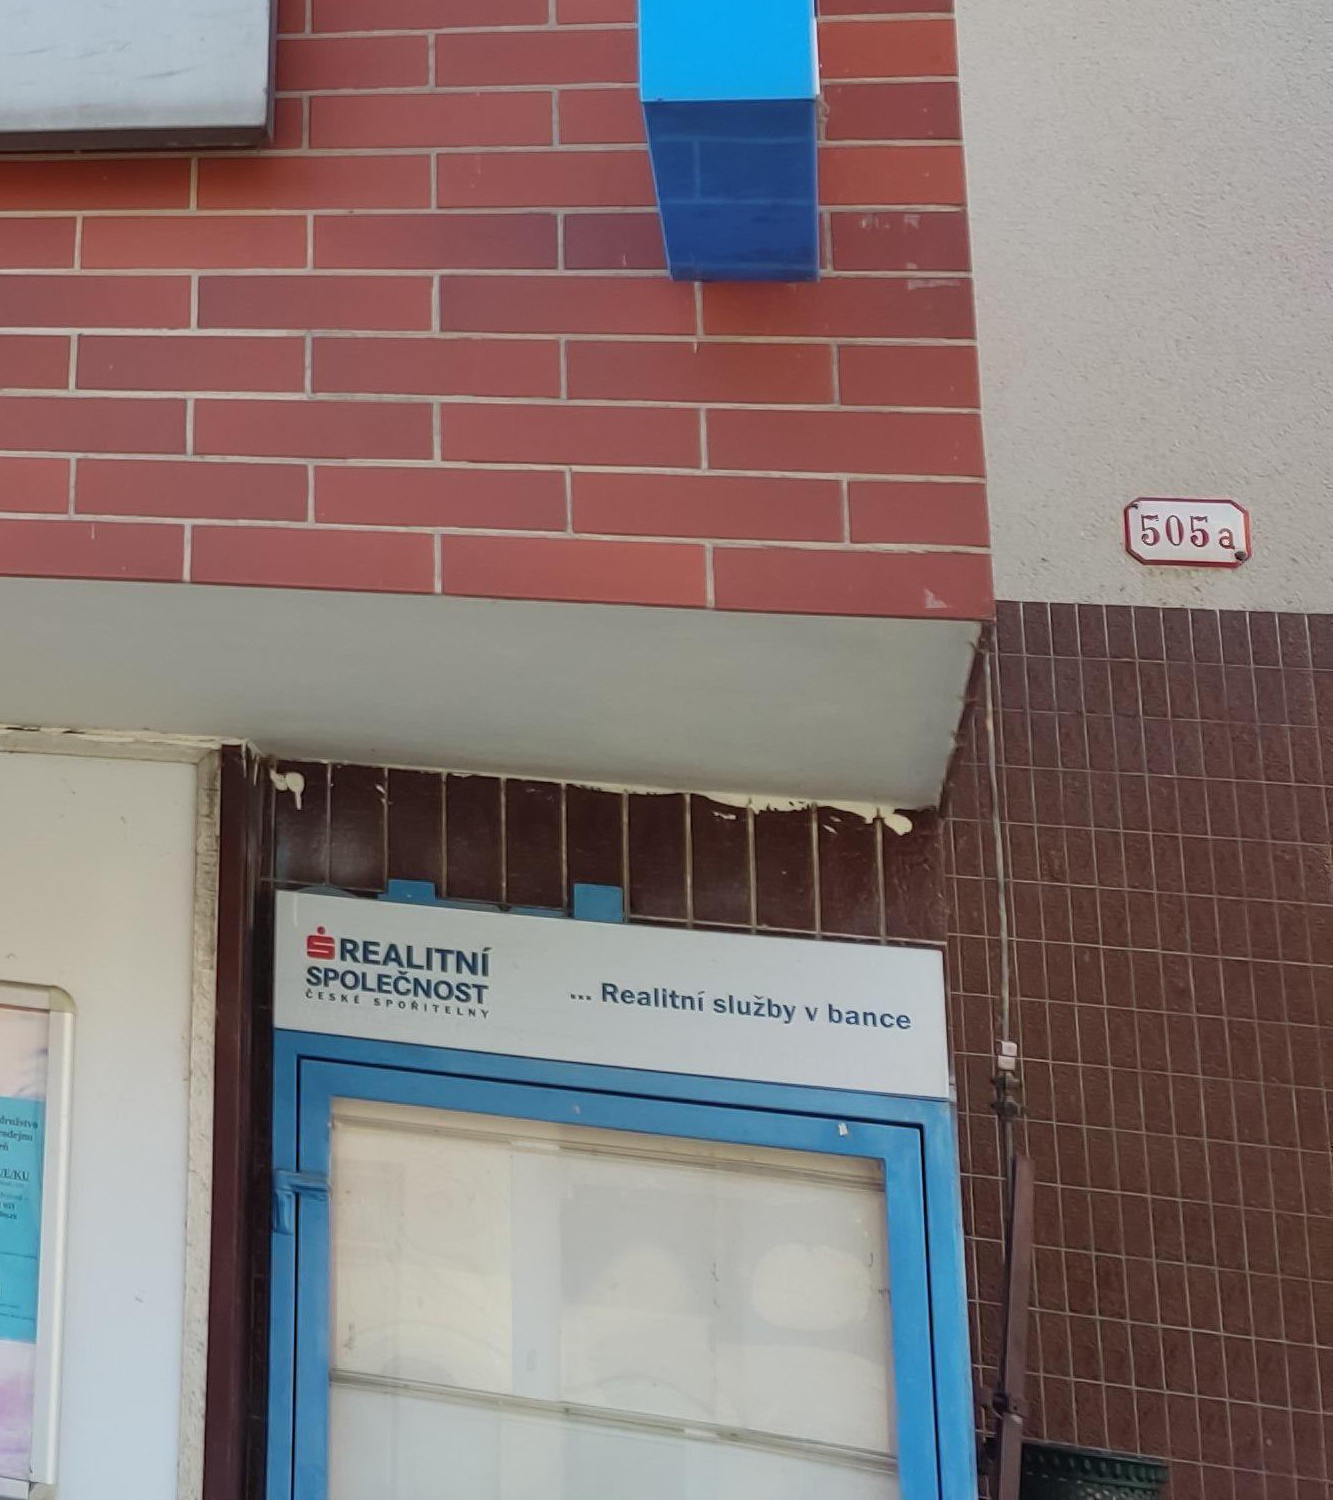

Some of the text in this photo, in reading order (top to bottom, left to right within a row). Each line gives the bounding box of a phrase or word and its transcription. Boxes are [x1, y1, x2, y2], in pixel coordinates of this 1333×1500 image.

[340, 938, 492, 977] REALITNÍ
[305, 988, 489, 1019] ČESKÉ SPOŘITELNY
[306, 966, 489, 1004] SPOLEČNOST
[601, 982, 706, 1011] Realitní
[713, 994, 796, 1024] služby
[804, 1006, 818, 1022] v
[828, 1003, 911, 1030] bance
[0, 1115, 39, 1129] družstvo
